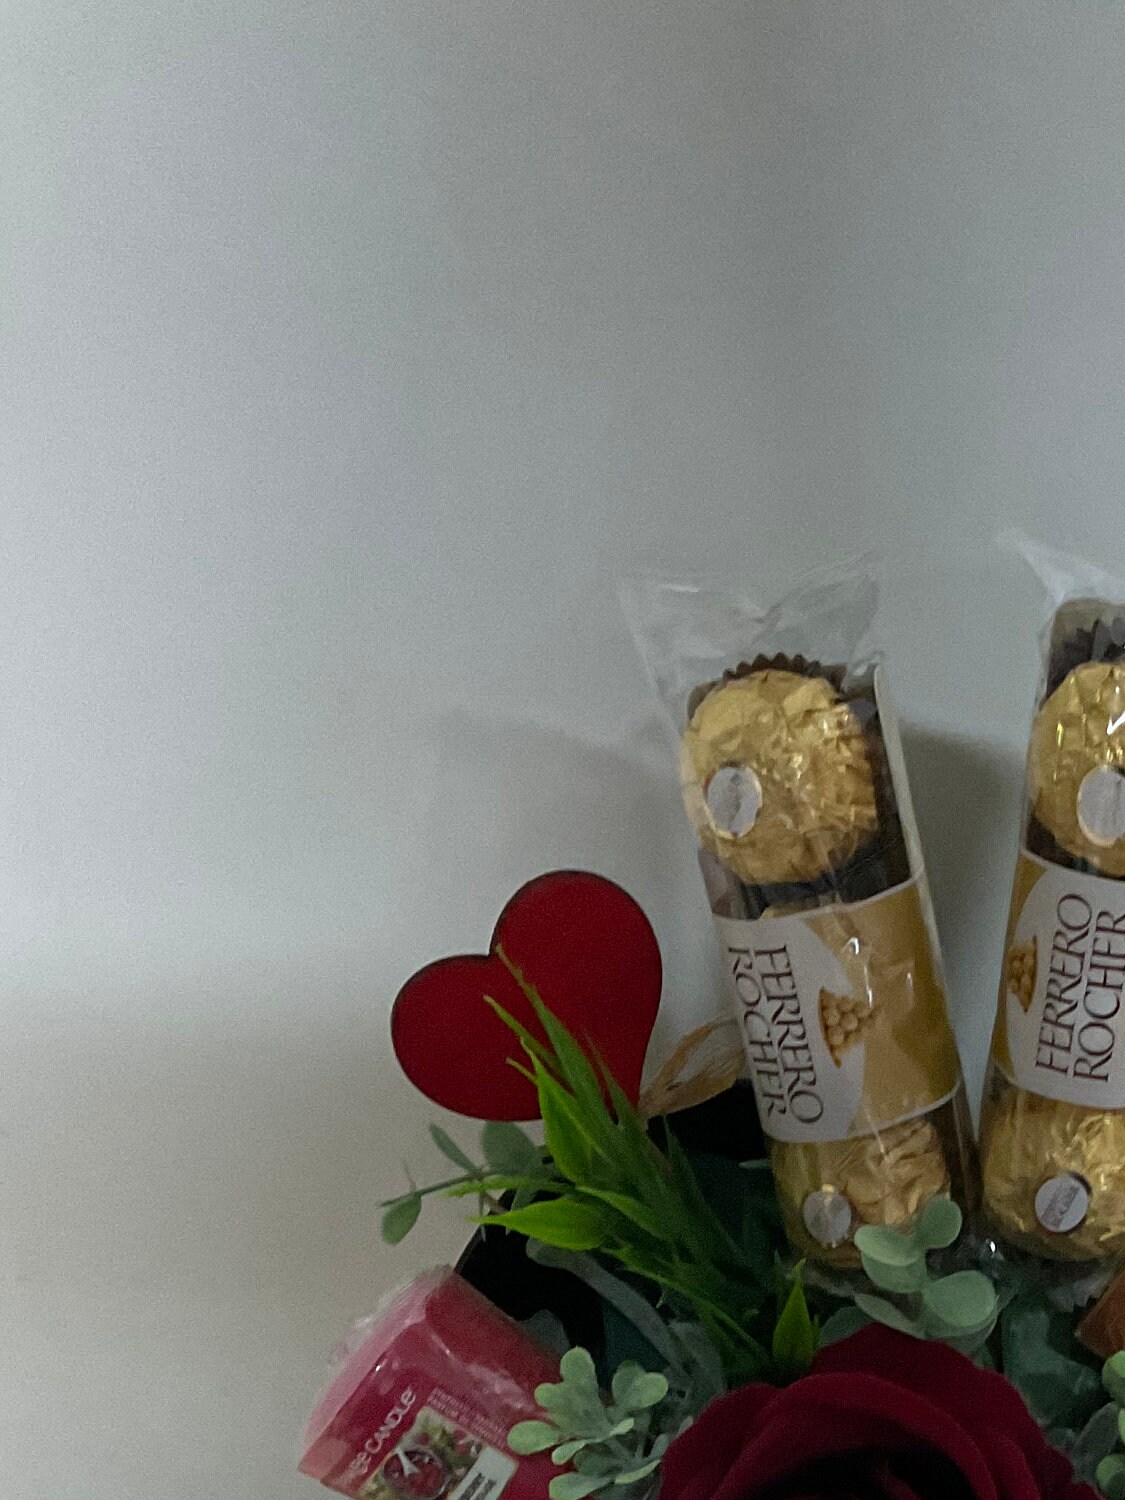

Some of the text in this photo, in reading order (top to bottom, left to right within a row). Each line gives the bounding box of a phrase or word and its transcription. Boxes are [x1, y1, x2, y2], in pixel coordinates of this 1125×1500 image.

[728, 946, 788, 1117] ROCHER
[754, 944, 824, 1124] FERRERO
[1034, 892, 1093, 1077] FERRERO
